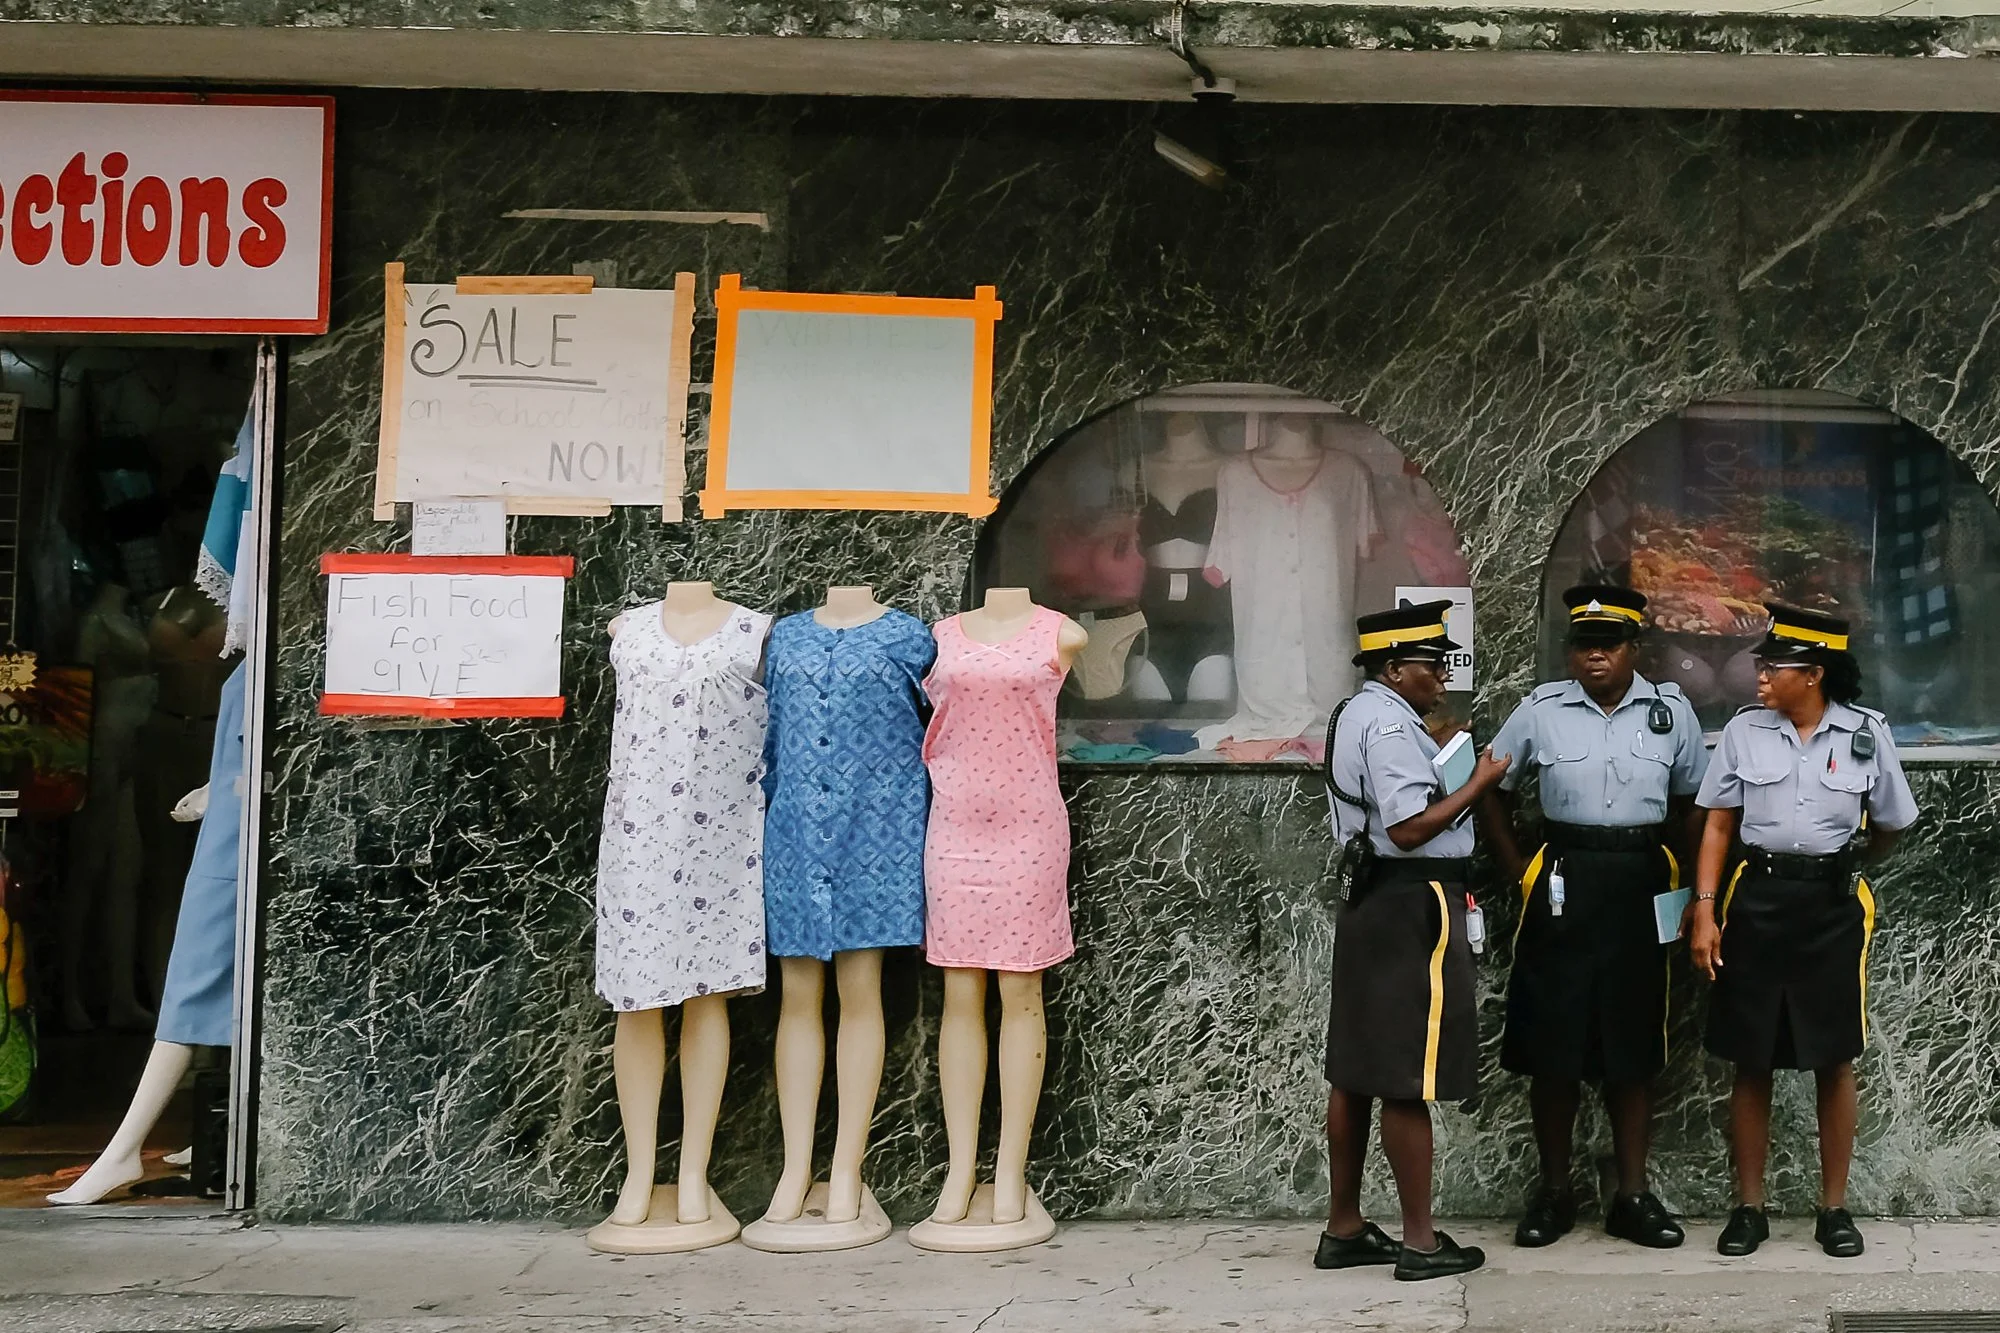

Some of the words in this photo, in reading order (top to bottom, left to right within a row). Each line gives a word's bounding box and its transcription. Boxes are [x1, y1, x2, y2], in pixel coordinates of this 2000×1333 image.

[0, 151, 288, 268] ctions
[410, 302, 577, 378] SALE
[407, 397, 446, 430] on
[467, 391, 583, 431] School
[337, 576, 428, 619] Fish
[448, 578, 529, 619] Food
[390, 626, 443, 655] for
